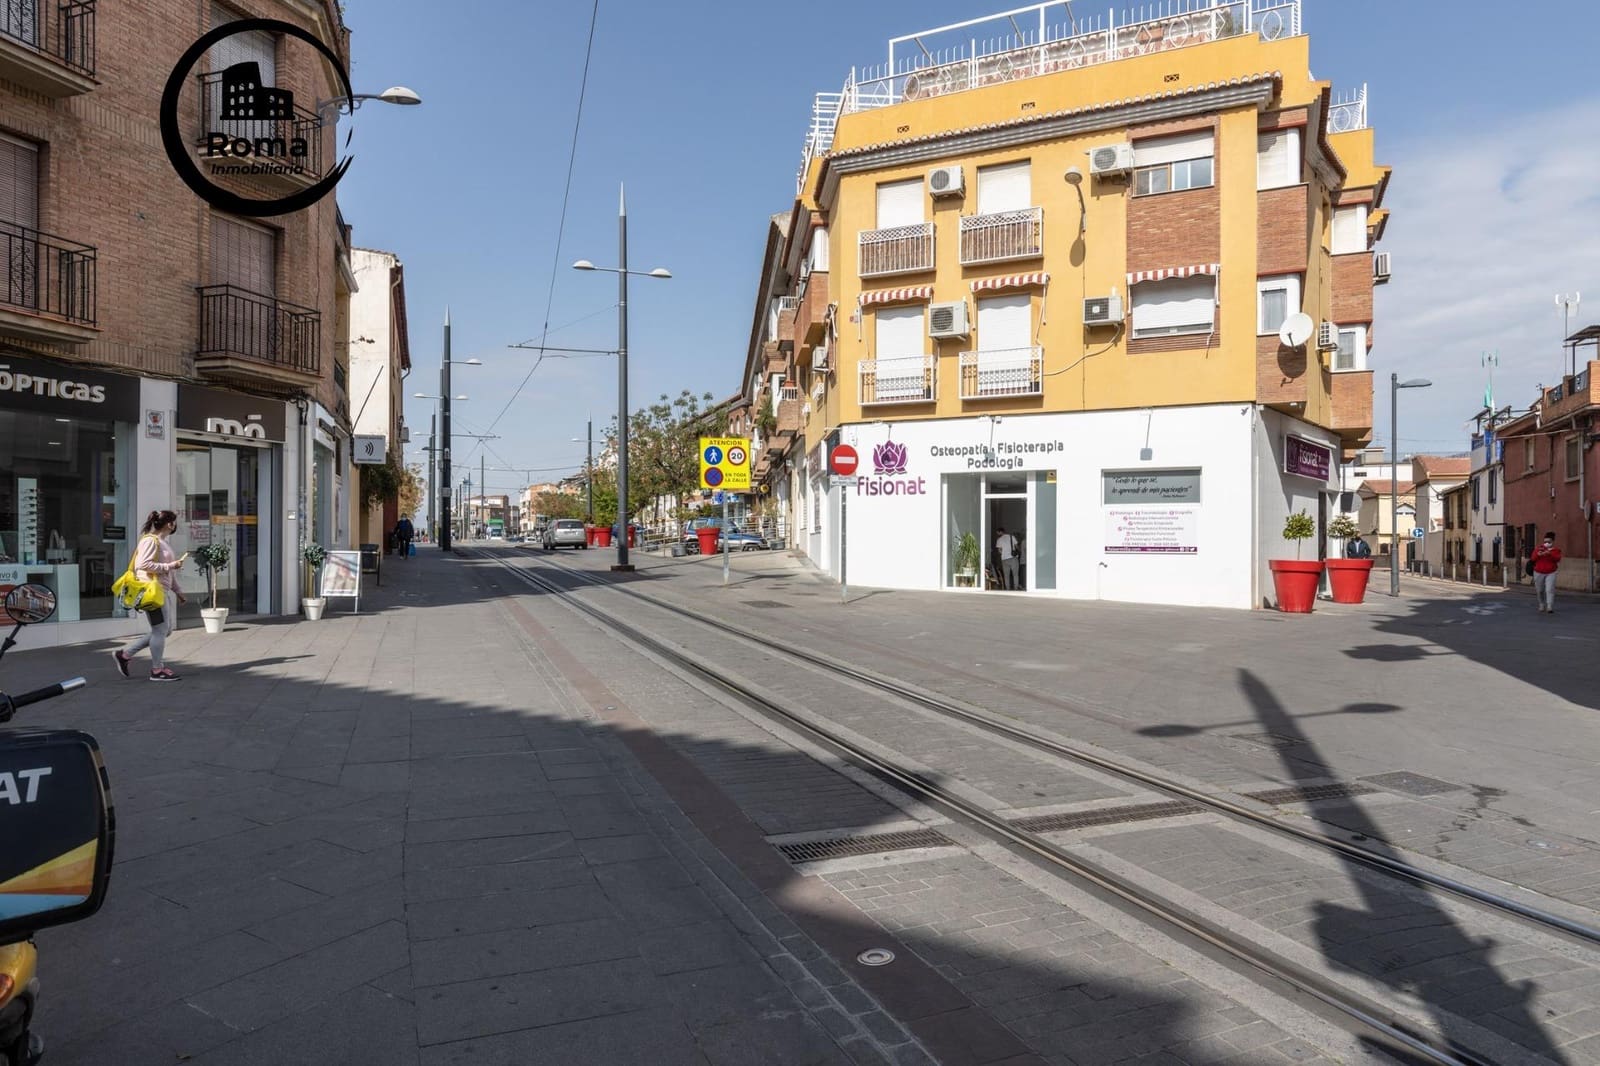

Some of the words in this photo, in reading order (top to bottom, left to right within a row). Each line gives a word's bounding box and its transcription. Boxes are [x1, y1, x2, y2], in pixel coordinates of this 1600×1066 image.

[731, 452, 743, 460] 20
[930, 443, 988, 457] Osteopatía
[997, 440, 1064, 454] Fisioterapia
[967, 456, 1023, 469] Podología
[857, 476, 926, 496] fisionat
